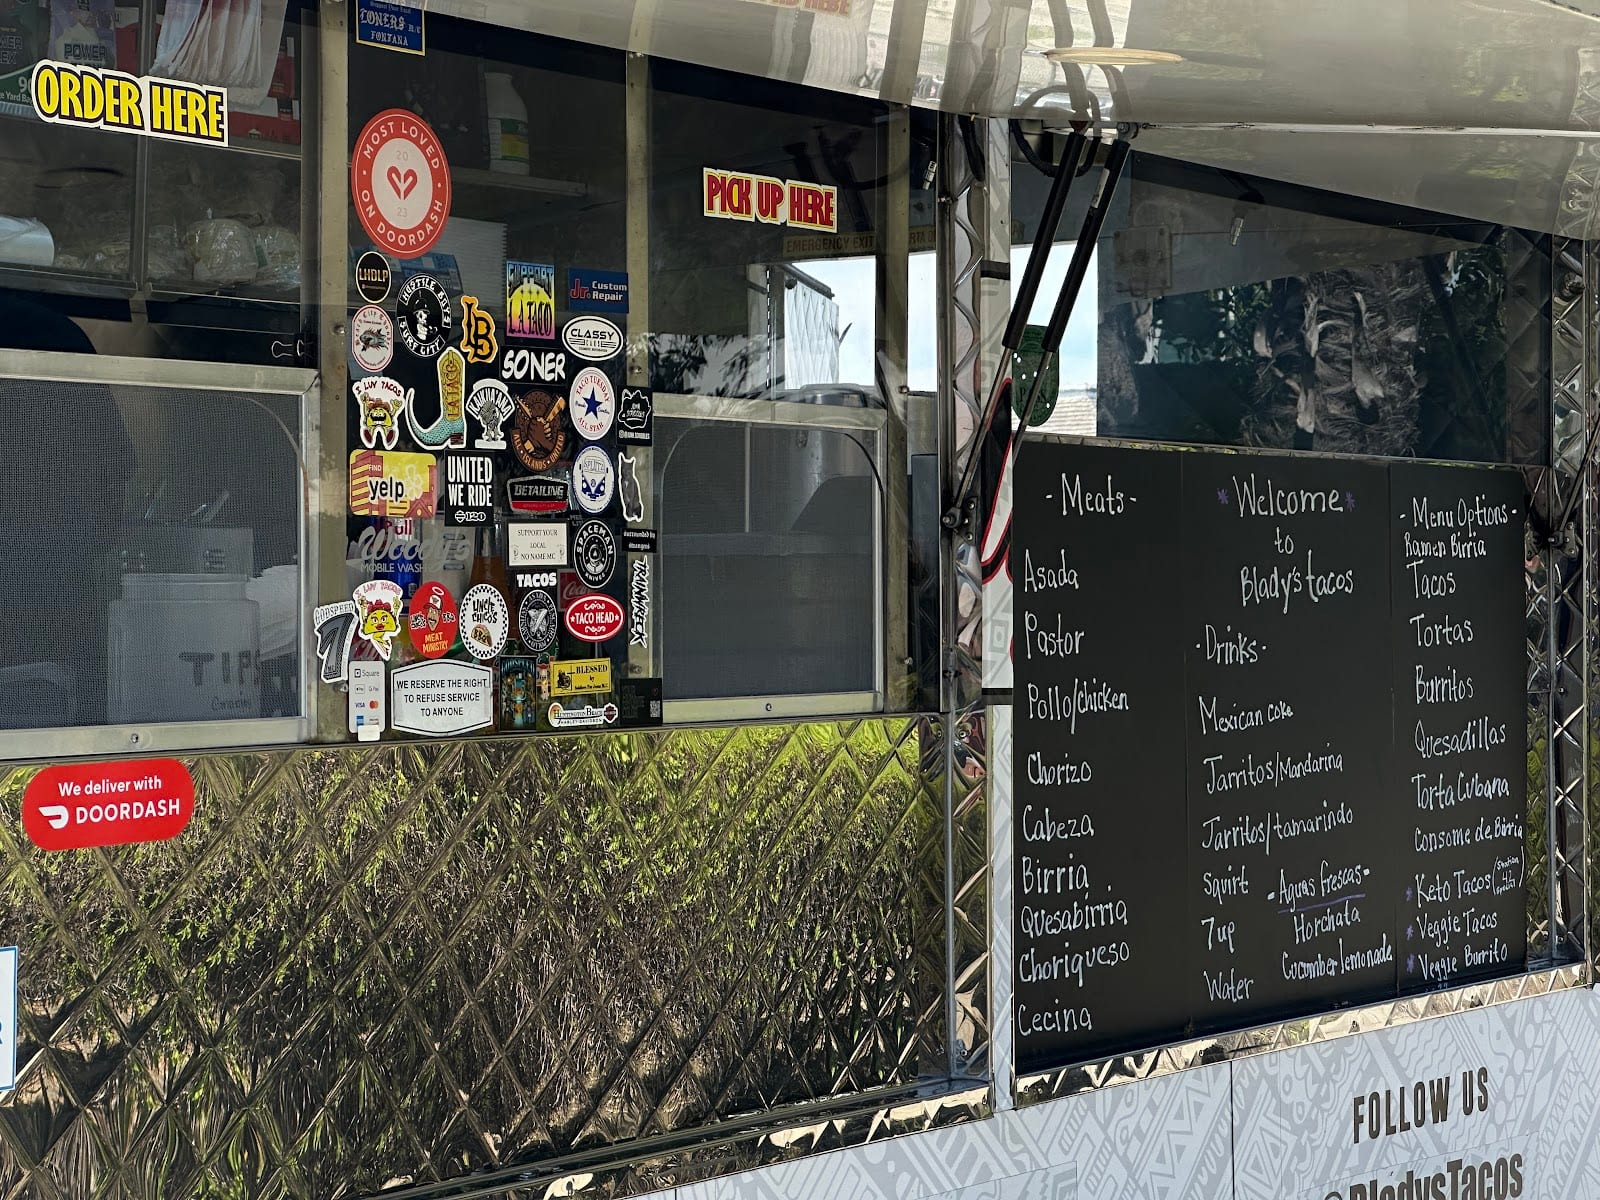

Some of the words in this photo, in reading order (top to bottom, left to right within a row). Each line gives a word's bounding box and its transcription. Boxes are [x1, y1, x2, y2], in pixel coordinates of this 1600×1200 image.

[360, 8, 406, 30] LONERS
[370, 30, 408, 46] FONTANA
[37, 68, 144, 127] ORDER
[150, 85, 223, 138] HERE
[363, 122, 395, 159] MOST
[402, 122, 440, 169] LOVED
[396, 150, 408, 161] 20
[706, 174, 751, 216] PICK
[756, 180, 784, 218] UP
[789, 186, 834, 227] HERE
[362, 190, 376, 218] ON
[377, 200, 443, 246] DOORDASH
[786, 236, 849, 252] EMERGENCY
[853, 235, 874, 248] EXIT
[402, 277, 436, 300] HOSTILE
[592, 281, 628, 292] Custom
[592, 291, 624, 302] Repair
[420, 340, 440, 355] CITY
[571, 328, 614, 340] CLASSY
[502, 350, 566, 382] SONER
[356, 386, 362, 394] I
[364, 381, 378, 390] LUV
[381, 381, 402, 396] TACOS
[576, 377, 588, 395] TACO
[590, 376, 610, 402] TUESDAY
[578, 418, 588, 430] ALL
[590, 422, 604, 432] STAR
[513, 434, 522, 450] ALL
[522, 454, 547, 470] ISLANDS
[550, 434, 564, 462] UNITED
[368, 464, 382, 472] FIND
[448, 456, 492, 484] UNITED
[369, 476, 404, 502] yelp
[448, 484, 464, 506] WE
[468, 484, 492, 506] RIDE
[514, 484, 564, 496] DETAILING
[1232, 473, 1344, 518] Welcome
[577, 524, 614, 554] SPACEMAN
[1274, 526, 1294, 554] to
[1404, 532, 1446, 558] Ramen
[1451, 531, 1487, 558] Birria
[360, 562, 395, 573] MOBILE
[398, 562, 426, 573] WASH
[516, 572, 557, 588] TACOS
[585, 572, 606, 582] KNIVES
[1024, 548, 1079, 592] Asada
[1240, 566, 1302, 614] Blady's
[1306, 549, 1354, 602] tacos
[1406, 559, 1456, 599] Tacos
[314, 603, 354, 625] GODSPEED
[574, 612, 594, 624] TACO
[596, 612, 614, 624] HEAD
[424, 632, 443, 643] MEAT
[1025, 611, 1085, 659] Pastor
[1409, 613, 1474, 646] Tortas
[422, 640, 448, 654] MINISTRY
[396, 680, 409, 689] WE
[410, 680, 446, 688] RESERVE
[447, 679, 462, 688] THE
[464, 678, 488, 687] RIGHT
[576, 664, 608, 674] BLESSED
[1416, 664, 1474, 704] Burritos
[404, 694, 414, 703] TO
[417, 694, 446, 702] REFUSE
[448, 692, 480, 701] SERVICE
[421, 708, 431, 716] TO
[433, 707, 463, 716] ANYONE
[1198, 696, 1264, 735] Mexican
[1414, 716, 1506, 759] Quesadillas
[1027, 751, 1092, 786] Chorizo
[58, 782, 81, 797] We
[84, 778, 130, 795] deliver
[134, 776, 162, 790] with
[1411, 773, 1455, 810] Torta
[1457, 771, 1509, 802] Cubana
[76, 798, 180, 824] DOORDASH
[1022, 804, 1095, 842] Cabeza
[1414, 827, 1470, 852] Consome
[1474, 816, 1492, 842] de
[1494, 814, 1523, 839] Birria
[1022, 853, 1090, 894] Birria
[1203, 865, 1249, 904] Squirt
[1415, 873, 1450, 908] Keto
[1453, 870, 1492, 899] Tacos
[1021, 884, 1128, 938] Quesabirria
[1294, 900, 1361, 944] Horchata
[1416, 910, 1460, 948] Veggie
[1463, 907, 1498, 936] Tacos
[1019, 941, 1130, 988] Choriqueso
[1339, 932, 1393, 974] lemonade
[1418, 947, 1457, 982] Veggie
[1464, 938, 1508, 967] Burrito
[1203, 968, 1254, 1003] Water
[1018, 998, 1093, 1036] Cecina
[1353, 1076, 1450, 1144] FOLLOW
[1462, 1067, 1489, 1116] US
[1324, 1153, 1522, 1200] dysTacos
